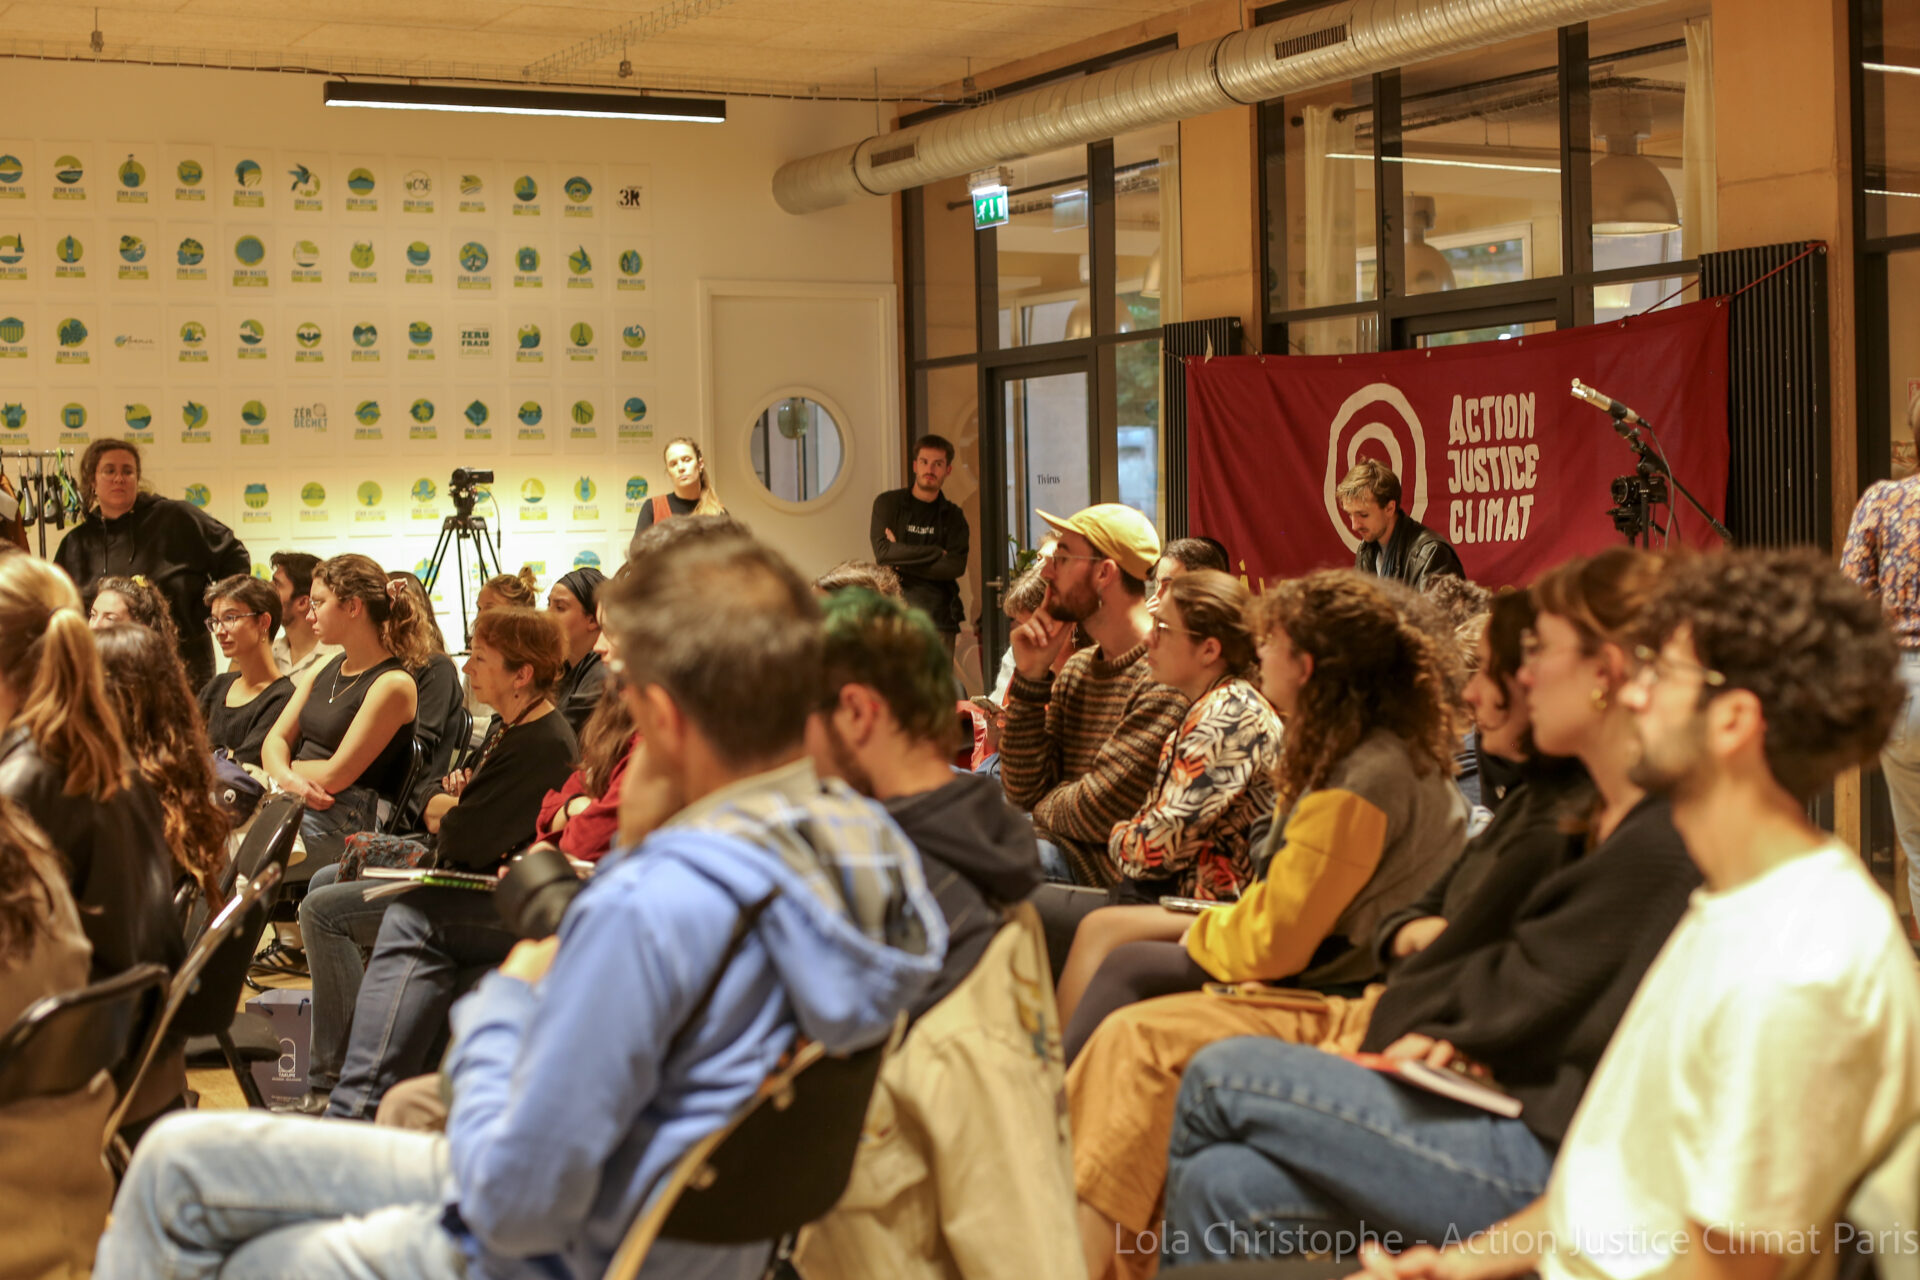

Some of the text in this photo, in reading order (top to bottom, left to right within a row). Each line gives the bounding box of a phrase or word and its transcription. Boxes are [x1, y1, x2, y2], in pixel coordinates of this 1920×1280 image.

[1448, 392, 1536, 445] ACTION
[1447, 444, 1540, 494] JUSTICE
[1450, 494, 1534, 544] CLIMAT
